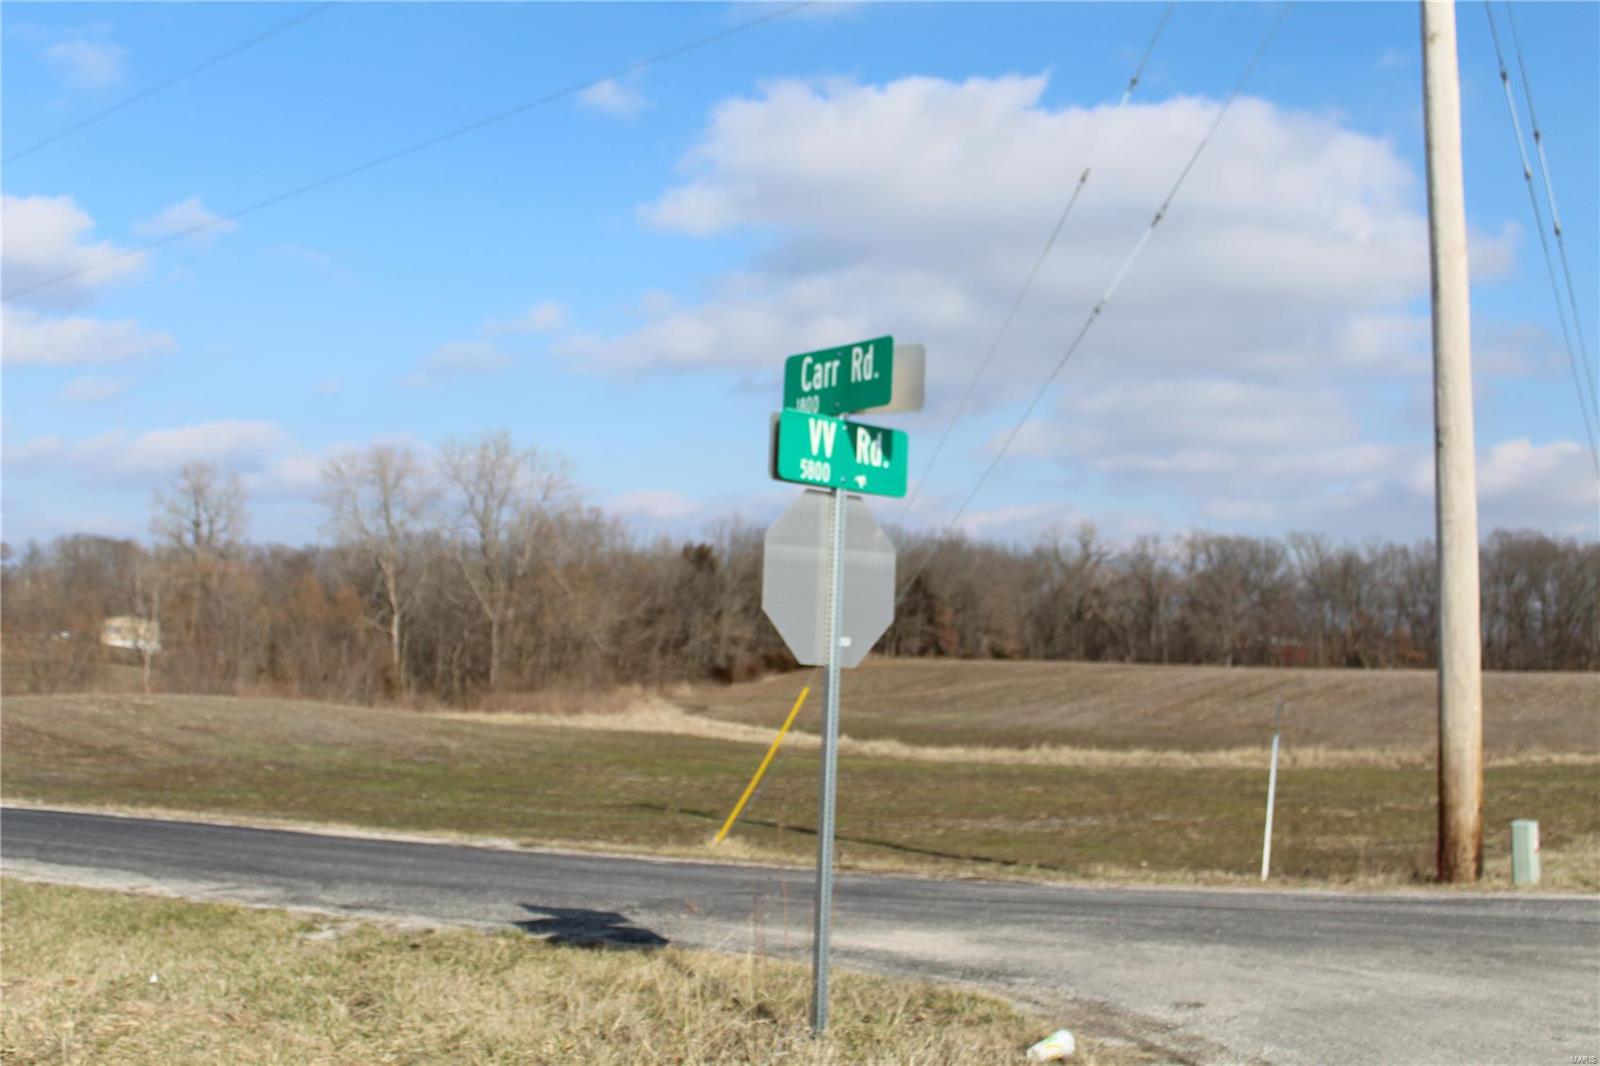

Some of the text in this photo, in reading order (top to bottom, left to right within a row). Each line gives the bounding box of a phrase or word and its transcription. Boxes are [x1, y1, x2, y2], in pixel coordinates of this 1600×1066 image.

[801, 344, 880, 392] Carr Rd.
[856, 426, 890, 469] Rd.
[800, 458, 831, 482] 5800
